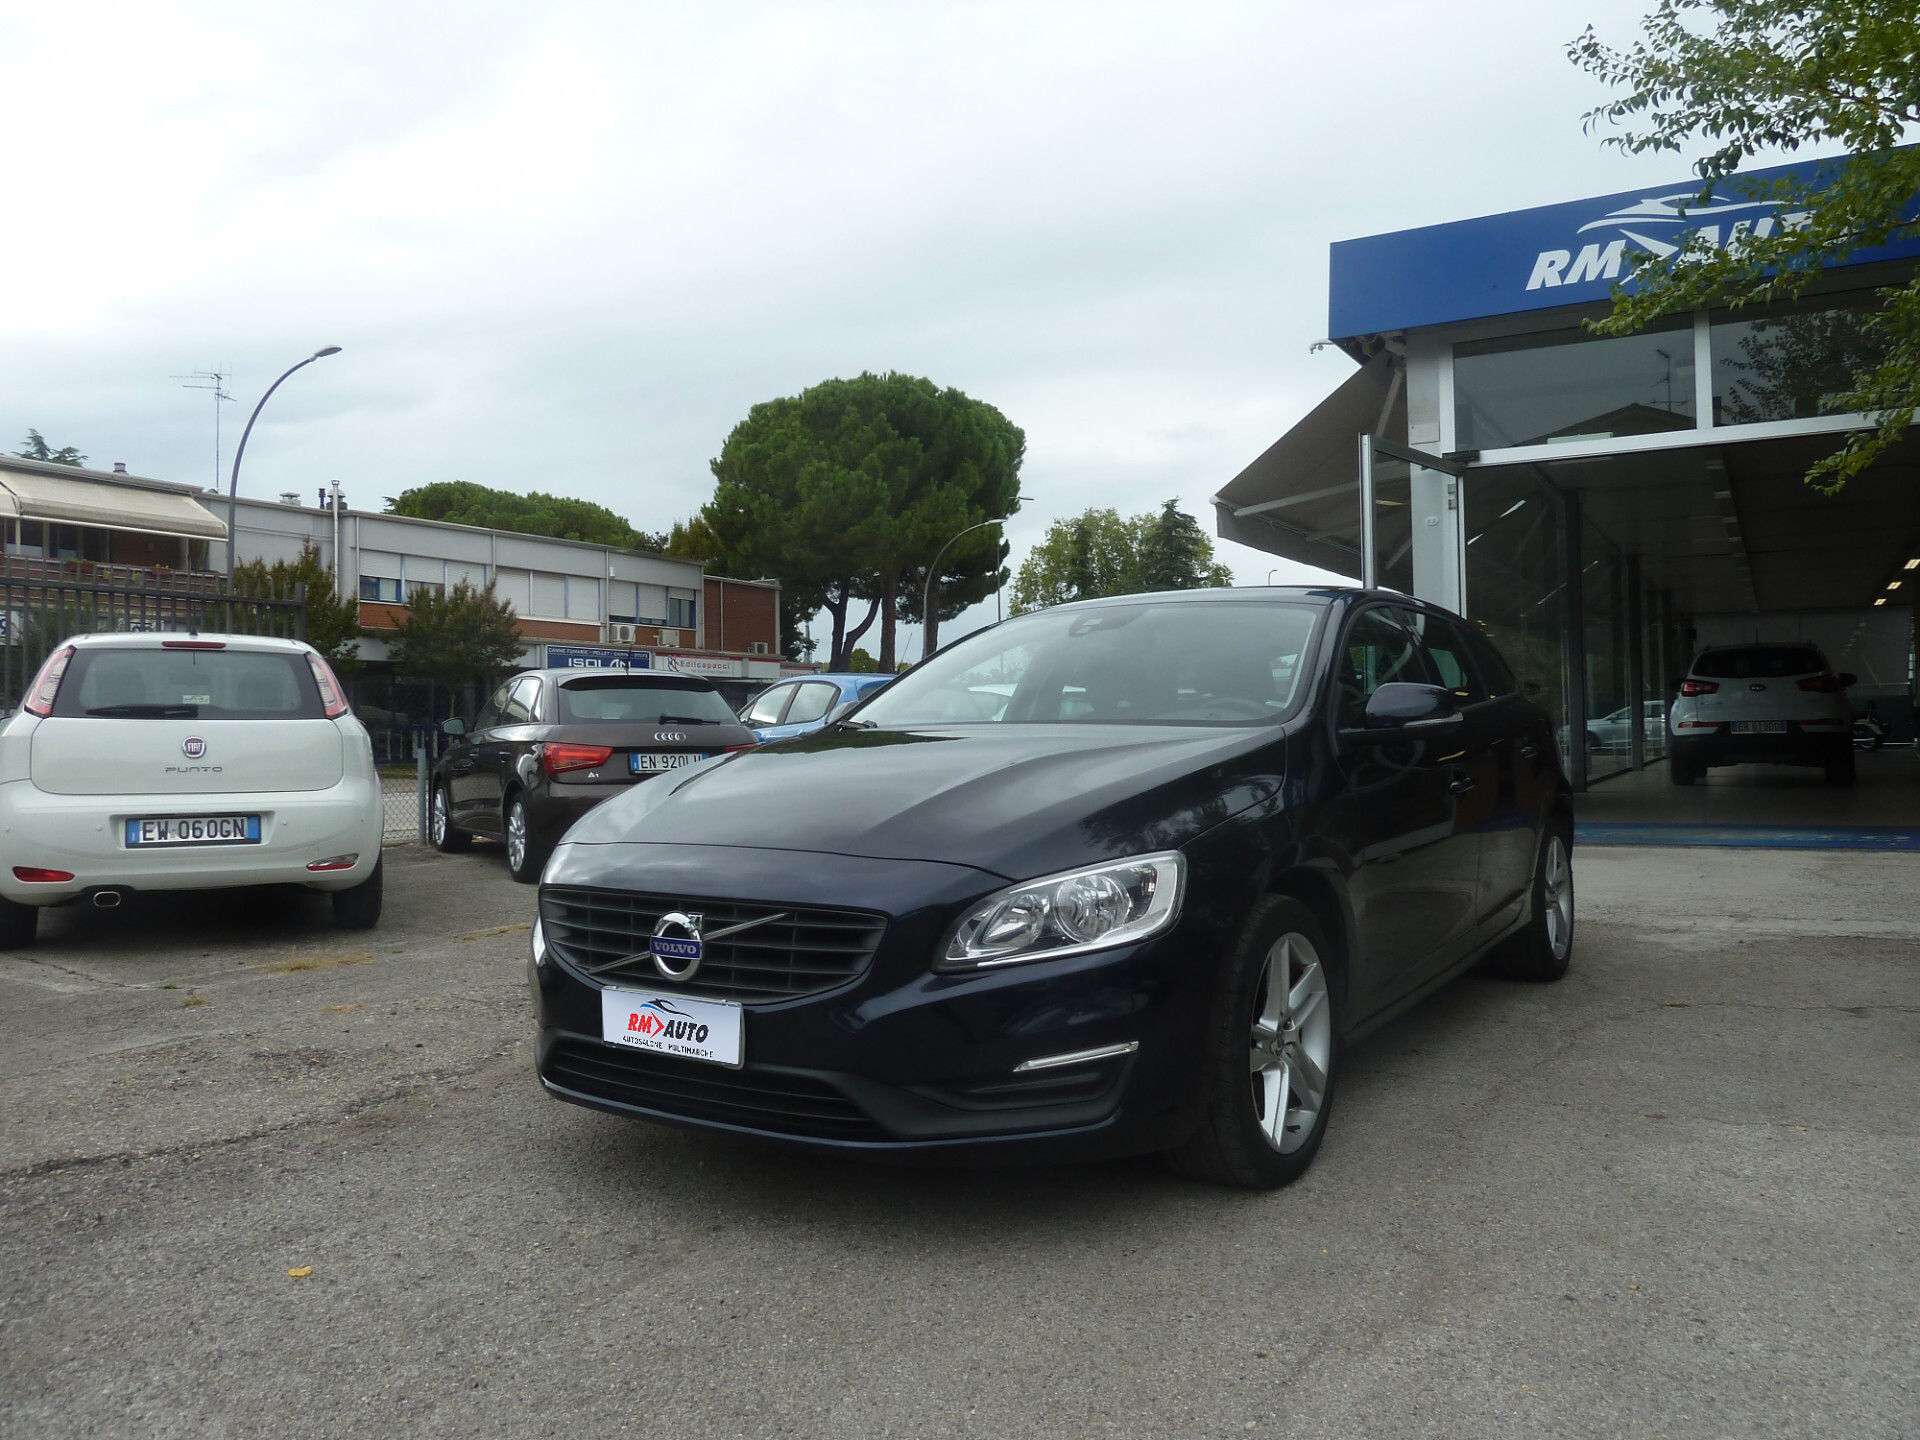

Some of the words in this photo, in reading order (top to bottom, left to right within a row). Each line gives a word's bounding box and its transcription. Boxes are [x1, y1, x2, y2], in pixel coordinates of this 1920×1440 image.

[1525, 239, 1626, 291] RM
[680, 660, 730, 670] Edilcapacci
[187, 742, 202, 752] FIAT
[640, 755, 656, 769] EN
[142, 820, 169, 841] EW
[178, 818, 245, 840] 060GN
[653, 941, 697, 955] VOLVO
[627, 1012, 653, 1034] RM
[662, 1019, 709, 1043] AUTO
[622, 1035, 663, 1050] AUTOSALONE
